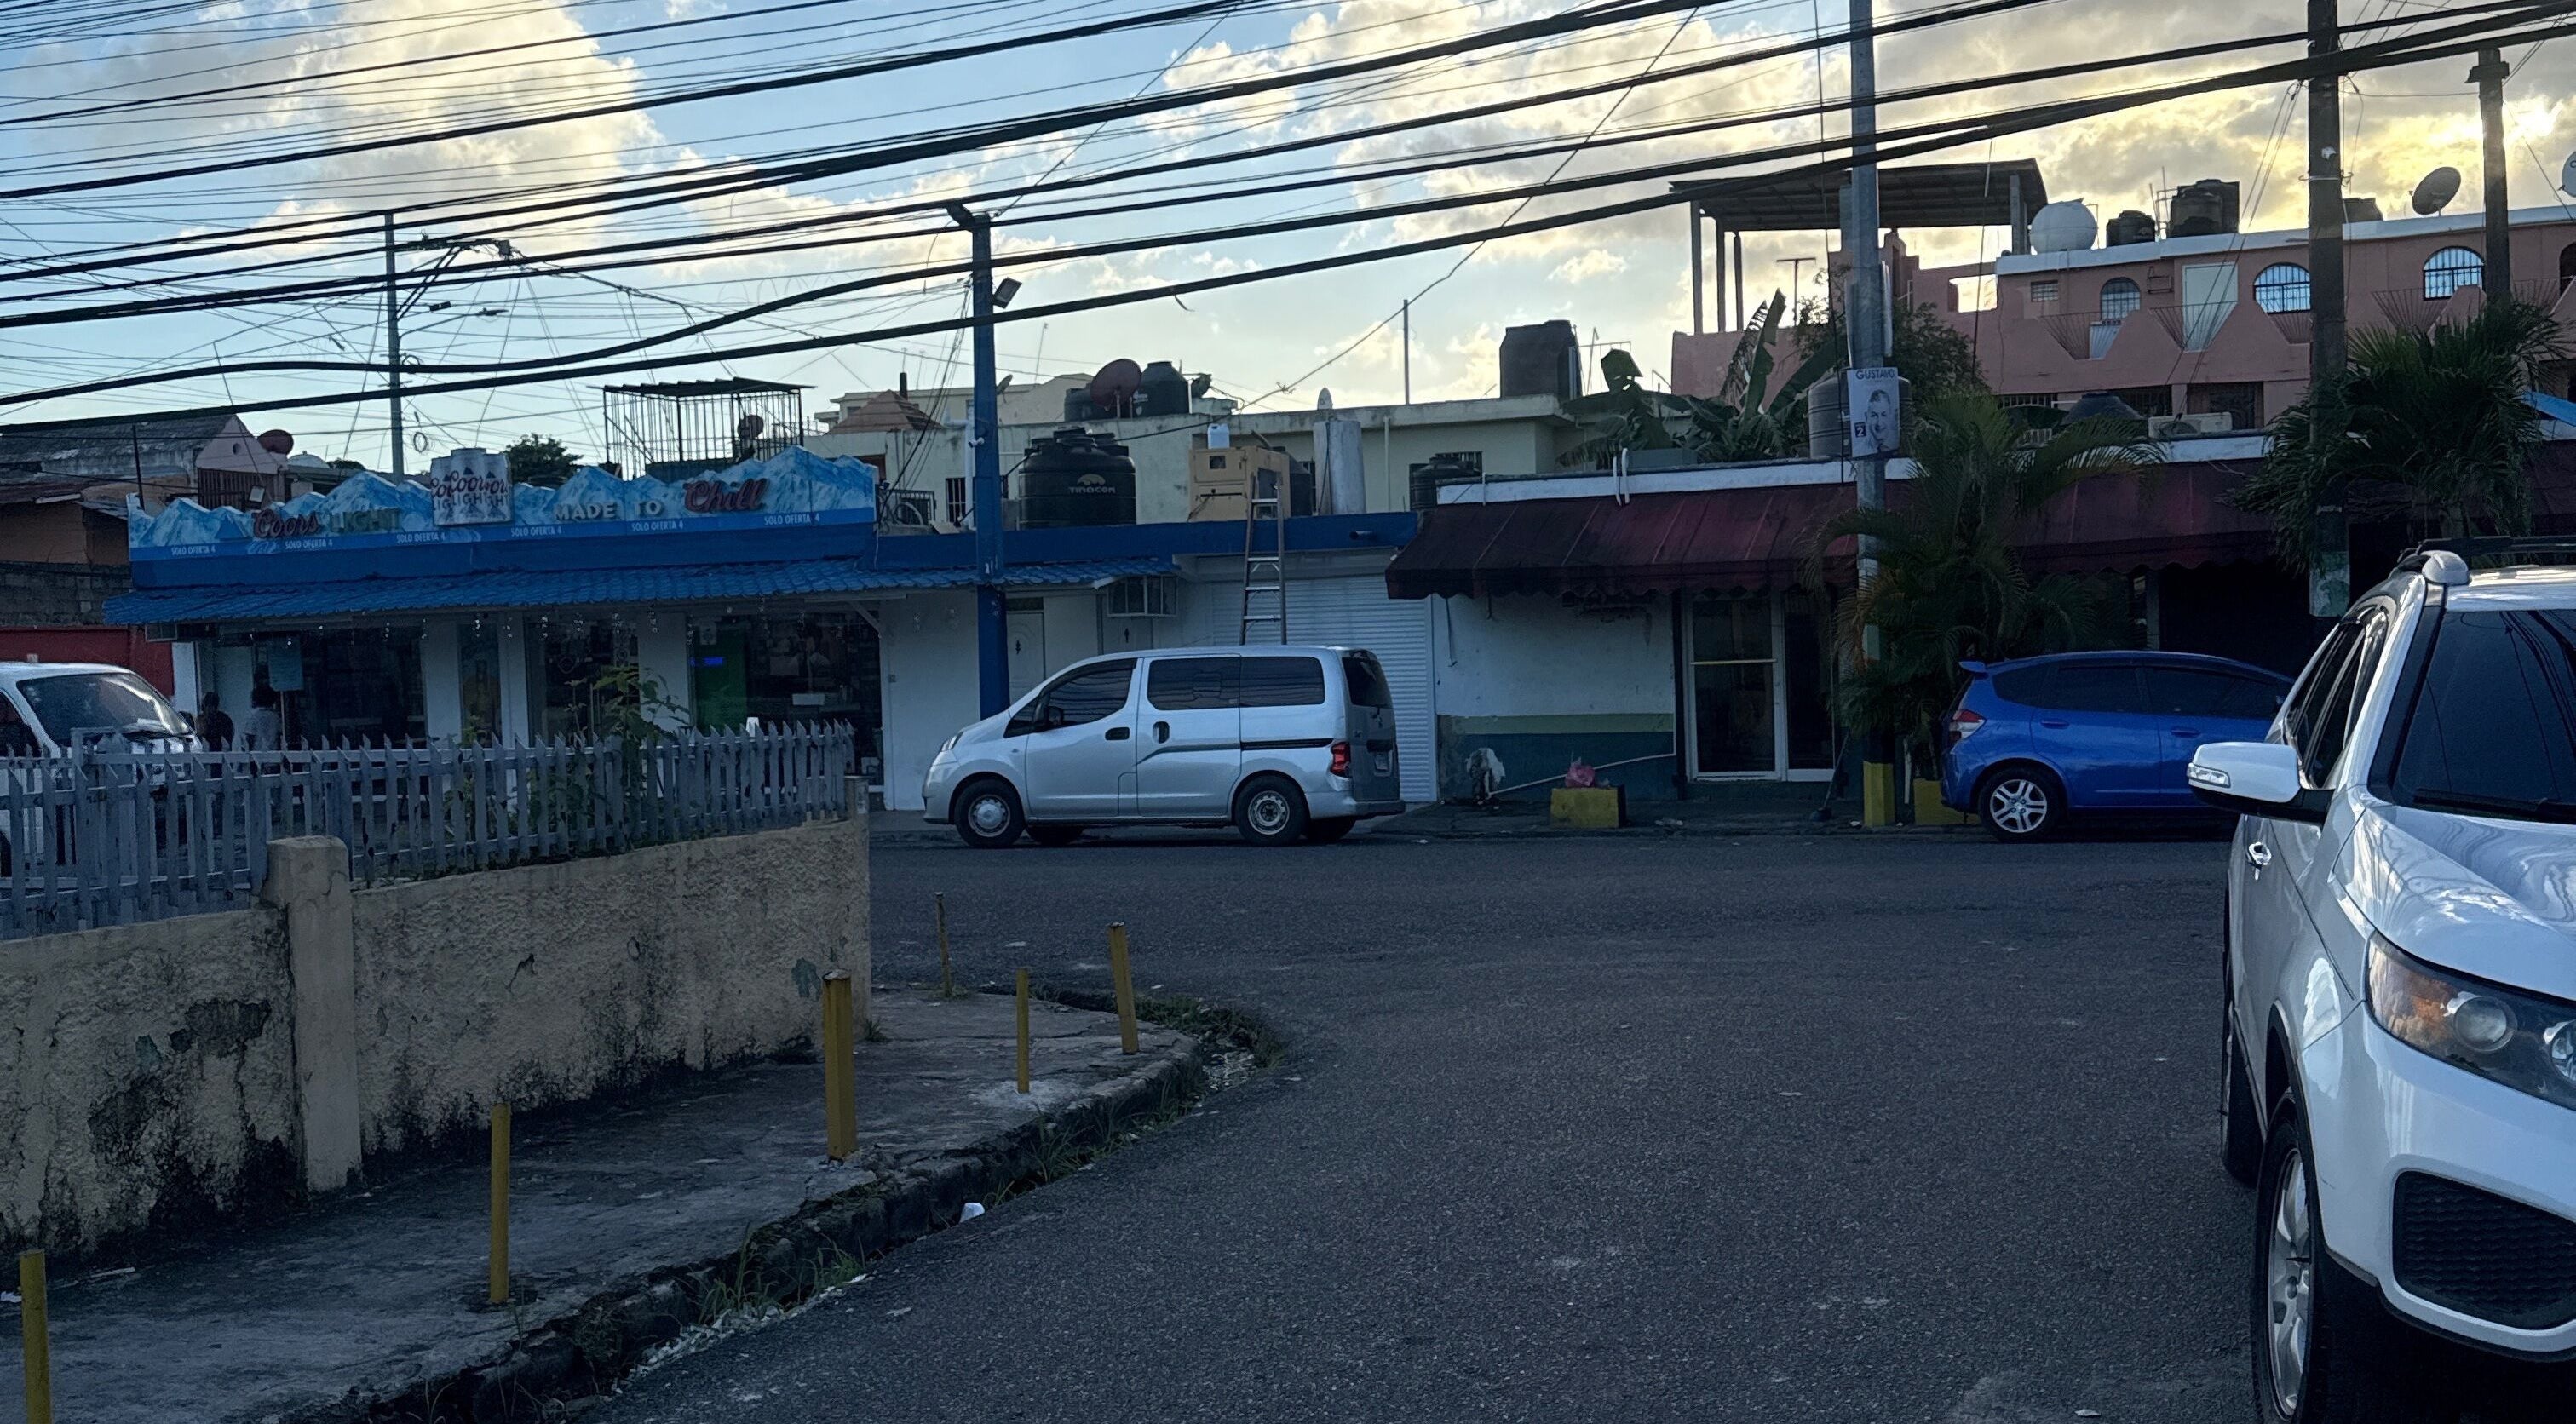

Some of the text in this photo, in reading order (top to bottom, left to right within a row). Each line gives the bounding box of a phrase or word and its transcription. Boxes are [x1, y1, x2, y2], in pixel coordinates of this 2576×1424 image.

[1855, 368, 1895, 380] GUSTAVO
[1856, 427, 1865, 437] 2
[554, 478, 770, 520] MADE TO Chill
[251, 508, 400, 539] Coors LIGHT
[764, 514, 784, 525] SOLO
[785, 513, 811, 524] OFERTA
[631, 522, 650, 531] SOLO
[650, 520, 676, 531] OFERTA
[511, 526, 529, 537] SOLO
[530, 526, 555, 537] OFERTA
[396, 533, 412, 543] SOLO
[414, 532, 438, 542] OFERTA
[171, 546, 187, 555] SOLO
[187, 545, 210, 554] OFERTA
[285, 540, 302, 550] SOLO
[303, 539, 326, 549] OFERTA
